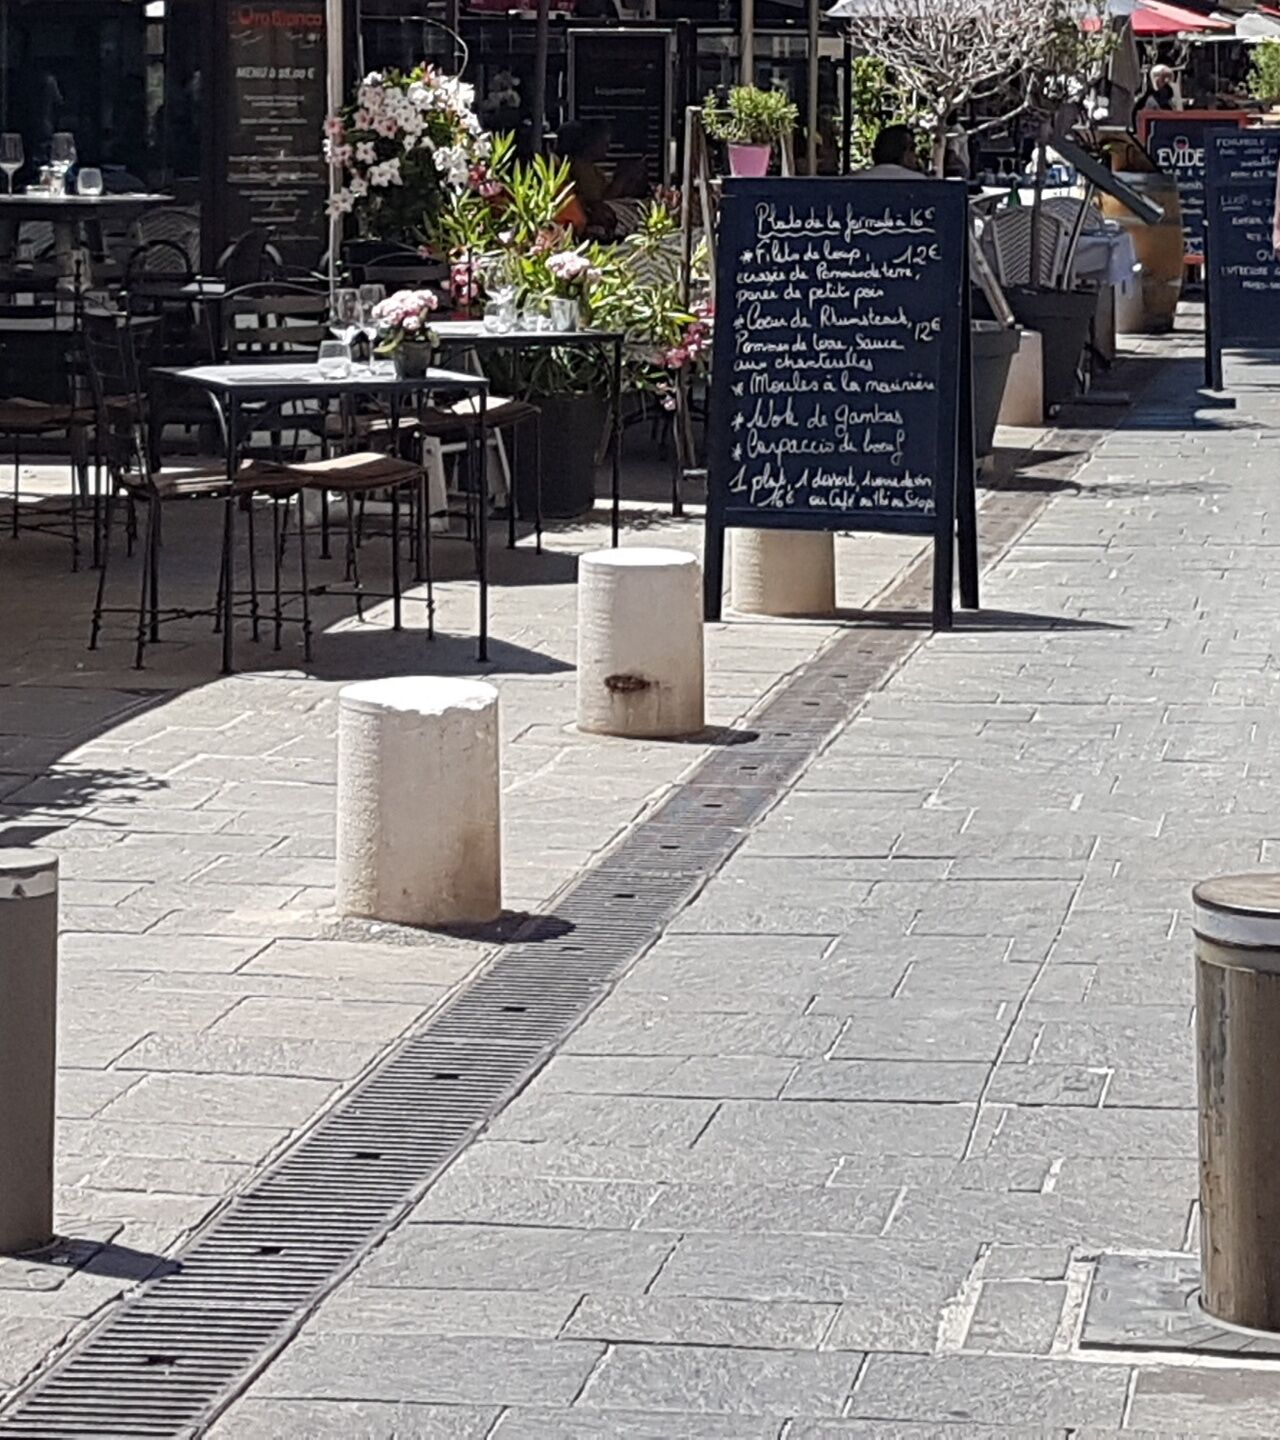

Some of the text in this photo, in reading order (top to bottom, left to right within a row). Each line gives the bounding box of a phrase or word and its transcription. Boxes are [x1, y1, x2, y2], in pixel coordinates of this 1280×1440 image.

[750, 371, 819, 395] Moules
[841, 371, 860, 391] la
[807, 403, 828, 428] de
